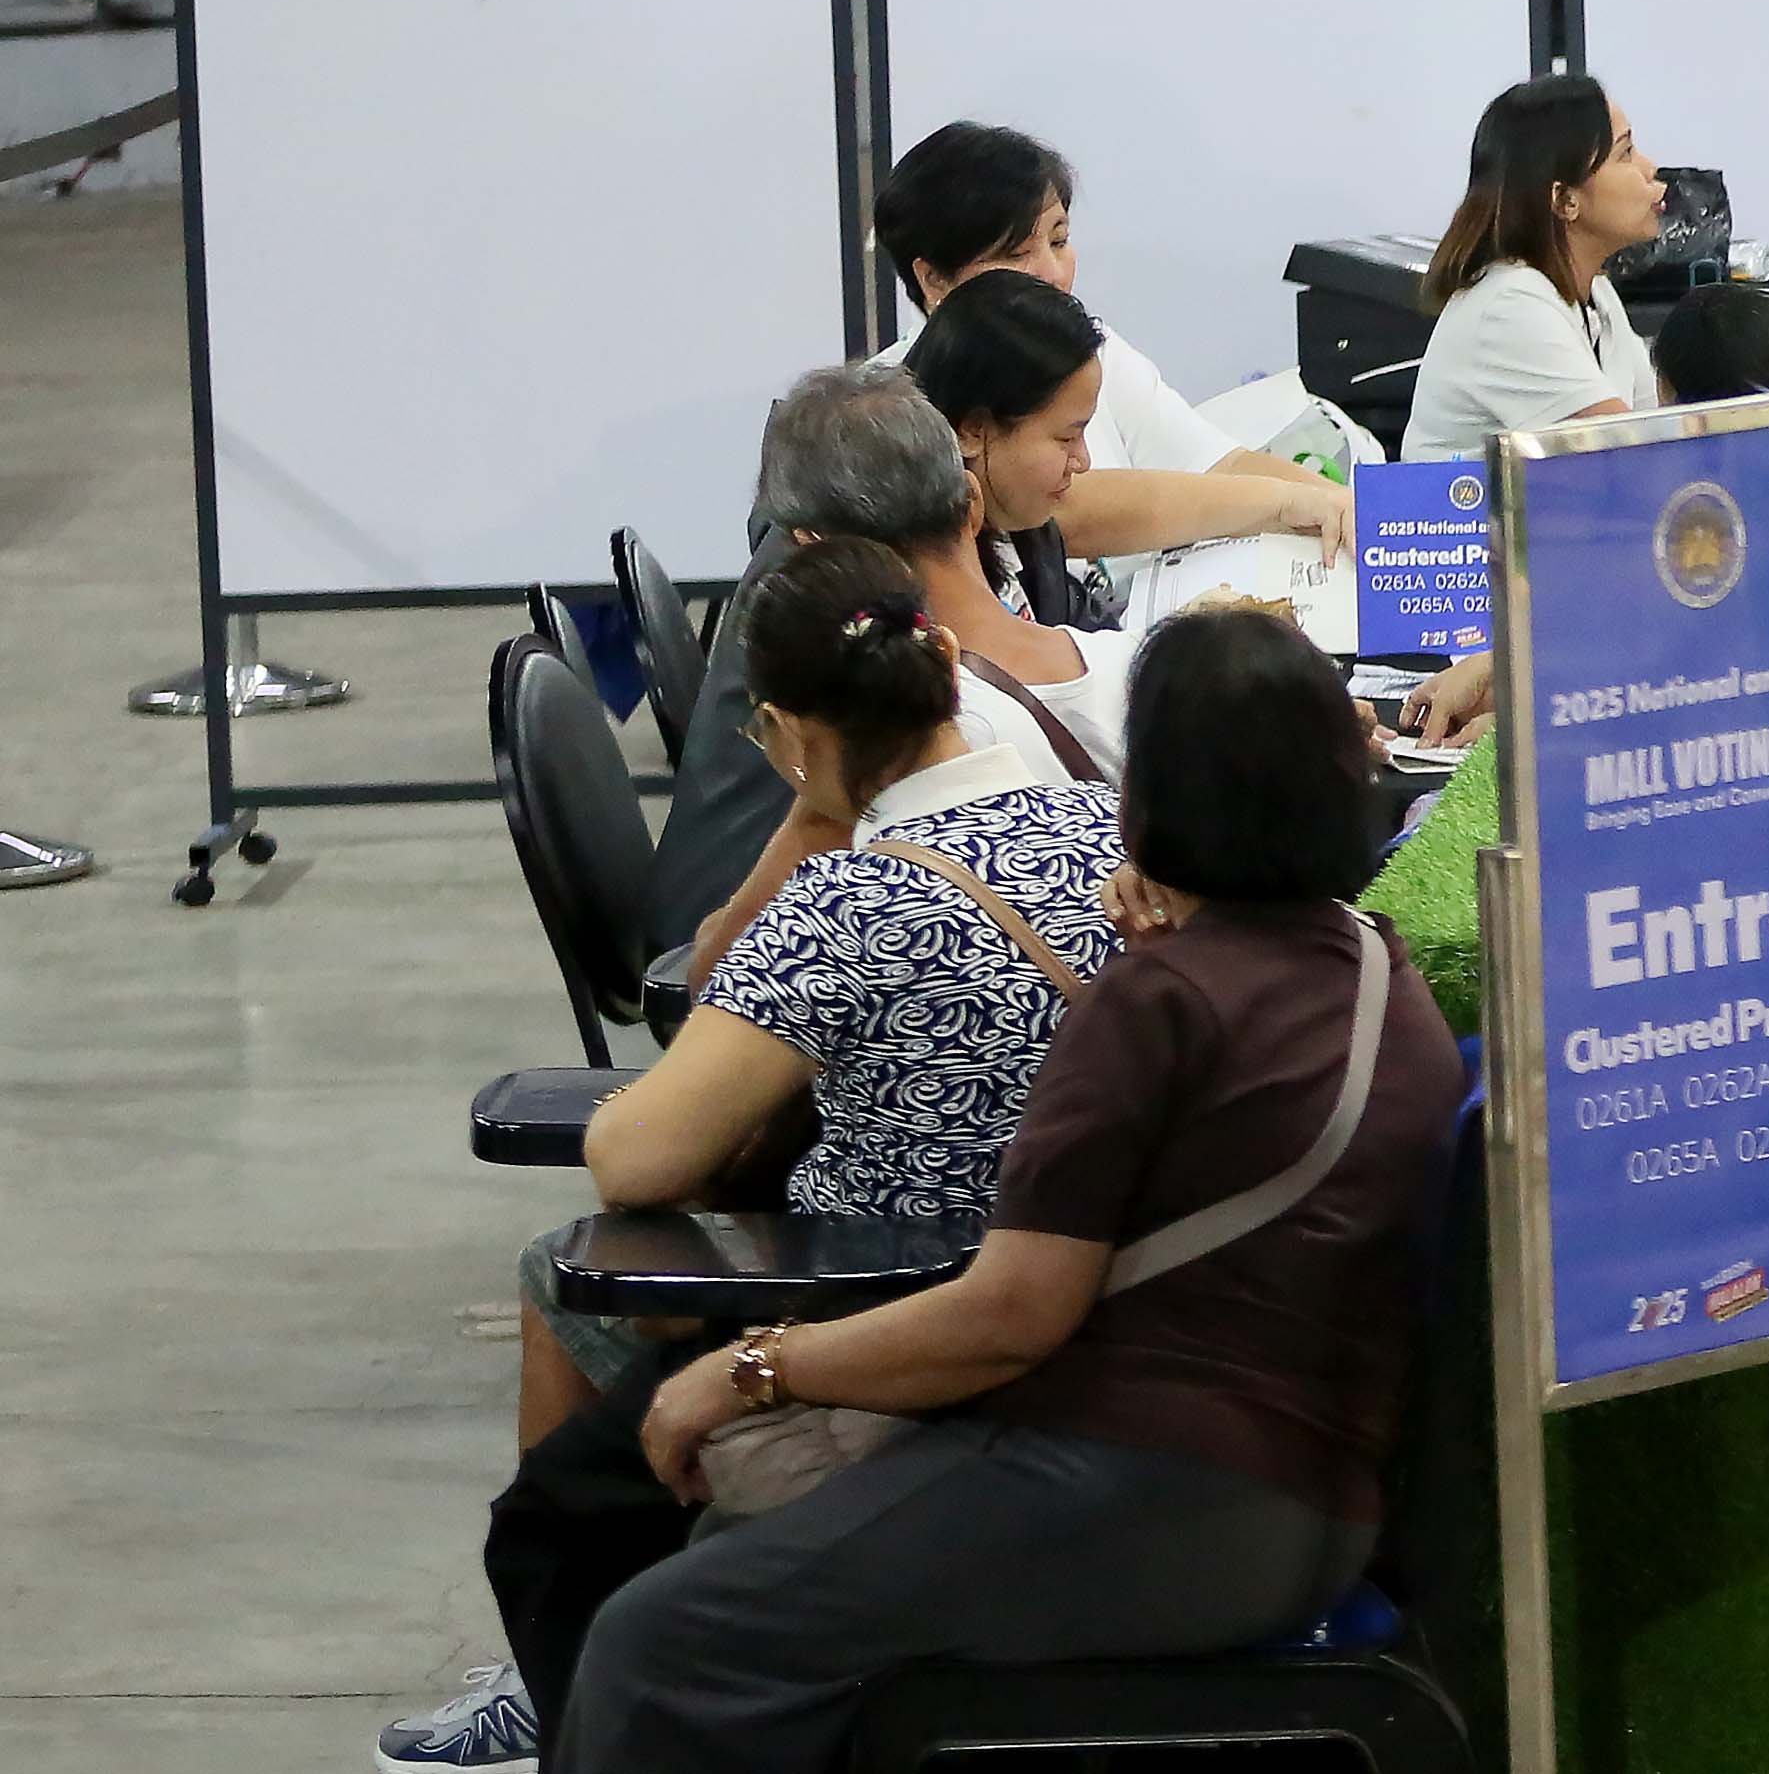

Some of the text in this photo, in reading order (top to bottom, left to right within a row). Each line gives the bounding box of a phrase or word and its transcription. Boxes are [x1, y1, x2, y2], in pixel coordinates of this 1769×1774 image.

[1378, 521, 1415, 537] 2025
[1417, 520, 1476, 536] National
[1364, 544, 1490, 568] Clustered Pr
[1371, 574, 1426, 591] 0261A
[1400, 597, 1455, 614] 0265A
[1551, 686, 1625, 726] 2025
[1627, 666, 1740, 713] National
[1585, 745, 1669, 806] MALL
[1694, 791, 1726, 813] and
[1564, 1009, 1733, 1074] Clustered
[1576, 1084, 1669, 1131] 0261A
[1627, 1138, 1720, 1185] 0265A
